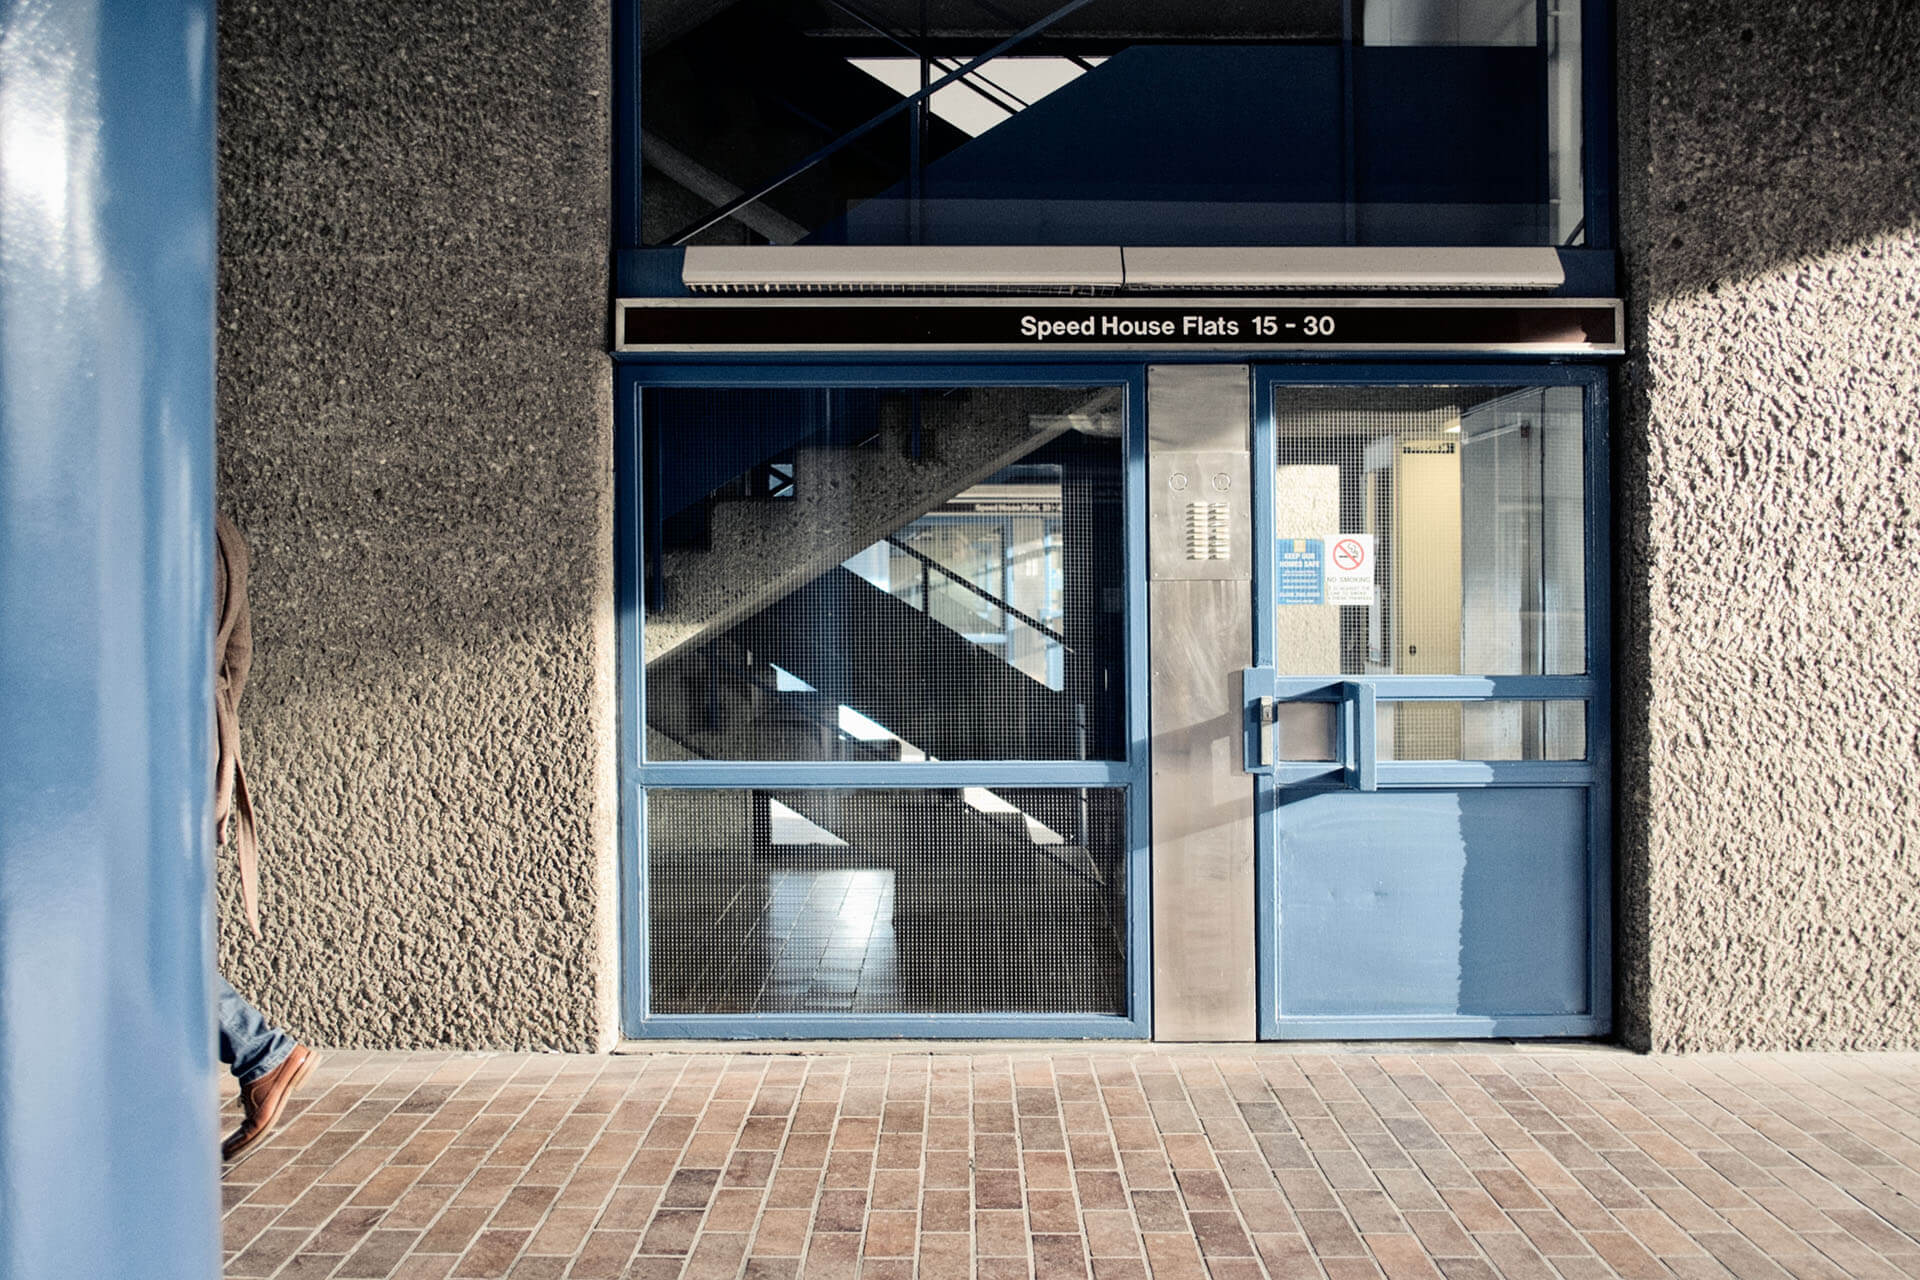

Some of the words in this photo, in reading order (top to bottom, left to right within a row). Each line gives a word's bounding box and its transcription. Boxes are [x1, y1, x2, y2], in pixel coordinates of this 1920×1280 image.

[1020, 316, 1095, 340] Speed
[1101, 316, 1176, 336] House
[1182, 316, 1240, 336] Flats
[1251, 316, 1278, 336] 15
[1303, 316, 1335, 336] 30
